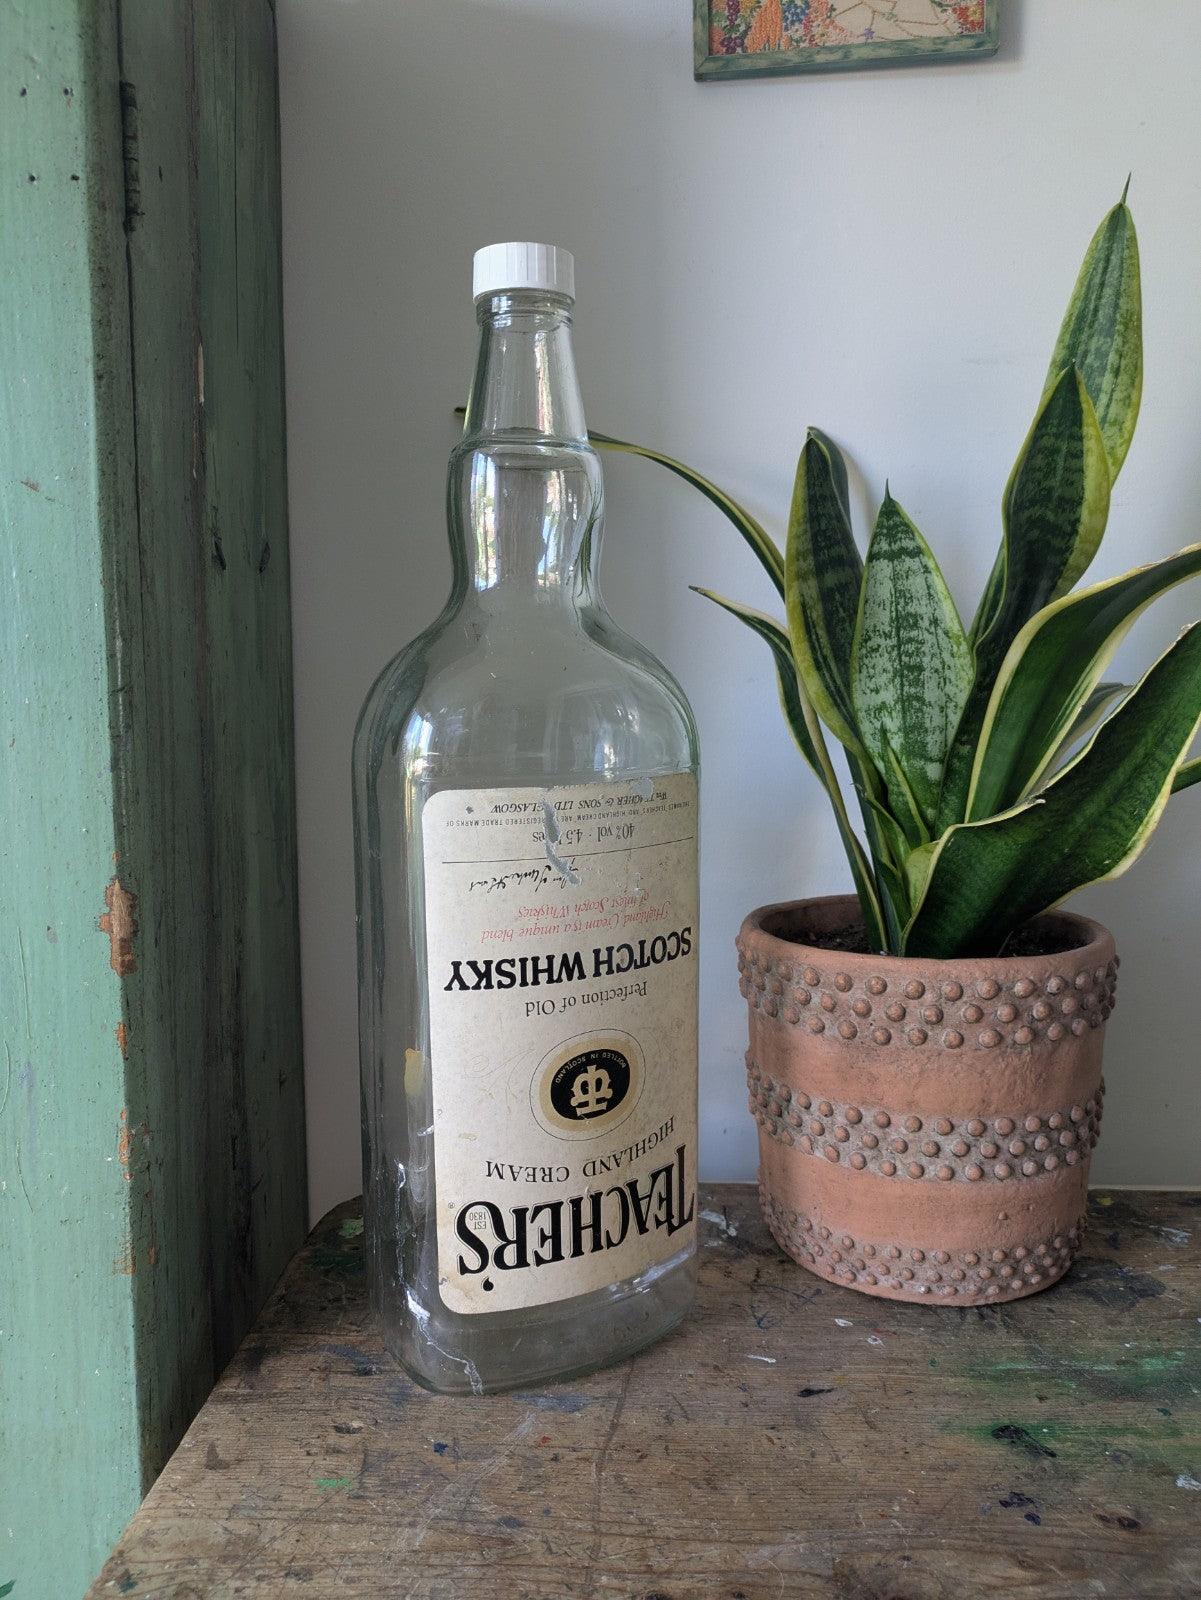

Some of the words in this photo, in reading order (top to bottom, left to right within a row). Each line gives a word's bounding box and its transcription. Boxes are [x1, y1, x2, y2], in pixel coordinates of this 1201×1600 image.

[491, 802, 544, 814] GLASGOW
[554, 800, 573, 810] LTD
[578, 799, 603, 809] SONS
[605, 798, 614, 807] &
[505, 817, 544, 825] REGISTERED
[566, 828, 583, 844] 4.5
[597, 826, 613, 842] vol
[615, 823, 635, 839] 40%
[517, 904, 569, 920] Whiskies
[574, 896, 608, 917] Scotch
[623, 901, 671, 925] Highland
[564, 923, 572, 933] a
[586, 911, 620, 930] Cream
[481, 929, 515, 943] blend
[519, 924, 560, 938] unique
[592, 926, 692, 978] SCOTCH
[444, 951, 586, 991] WHISKY
[582, 981, 647, 1004] Perfection
[525, 1000, 555, 1017] Old
[560, 996, 576, 1013] of
[602, 1052, 626, 1068] BOTTLED
[555, 1056, 585, 1083] SCOTLAND
[582, 1115, 675, 1177] HIGHLAND
[485, 1161, 569, 1183] CREAM
[454, 1145, 695, 1292] TEACHER'S
[470, 1211, 486, 1221] 1830
[473, 1221, 486, 1229] EST
